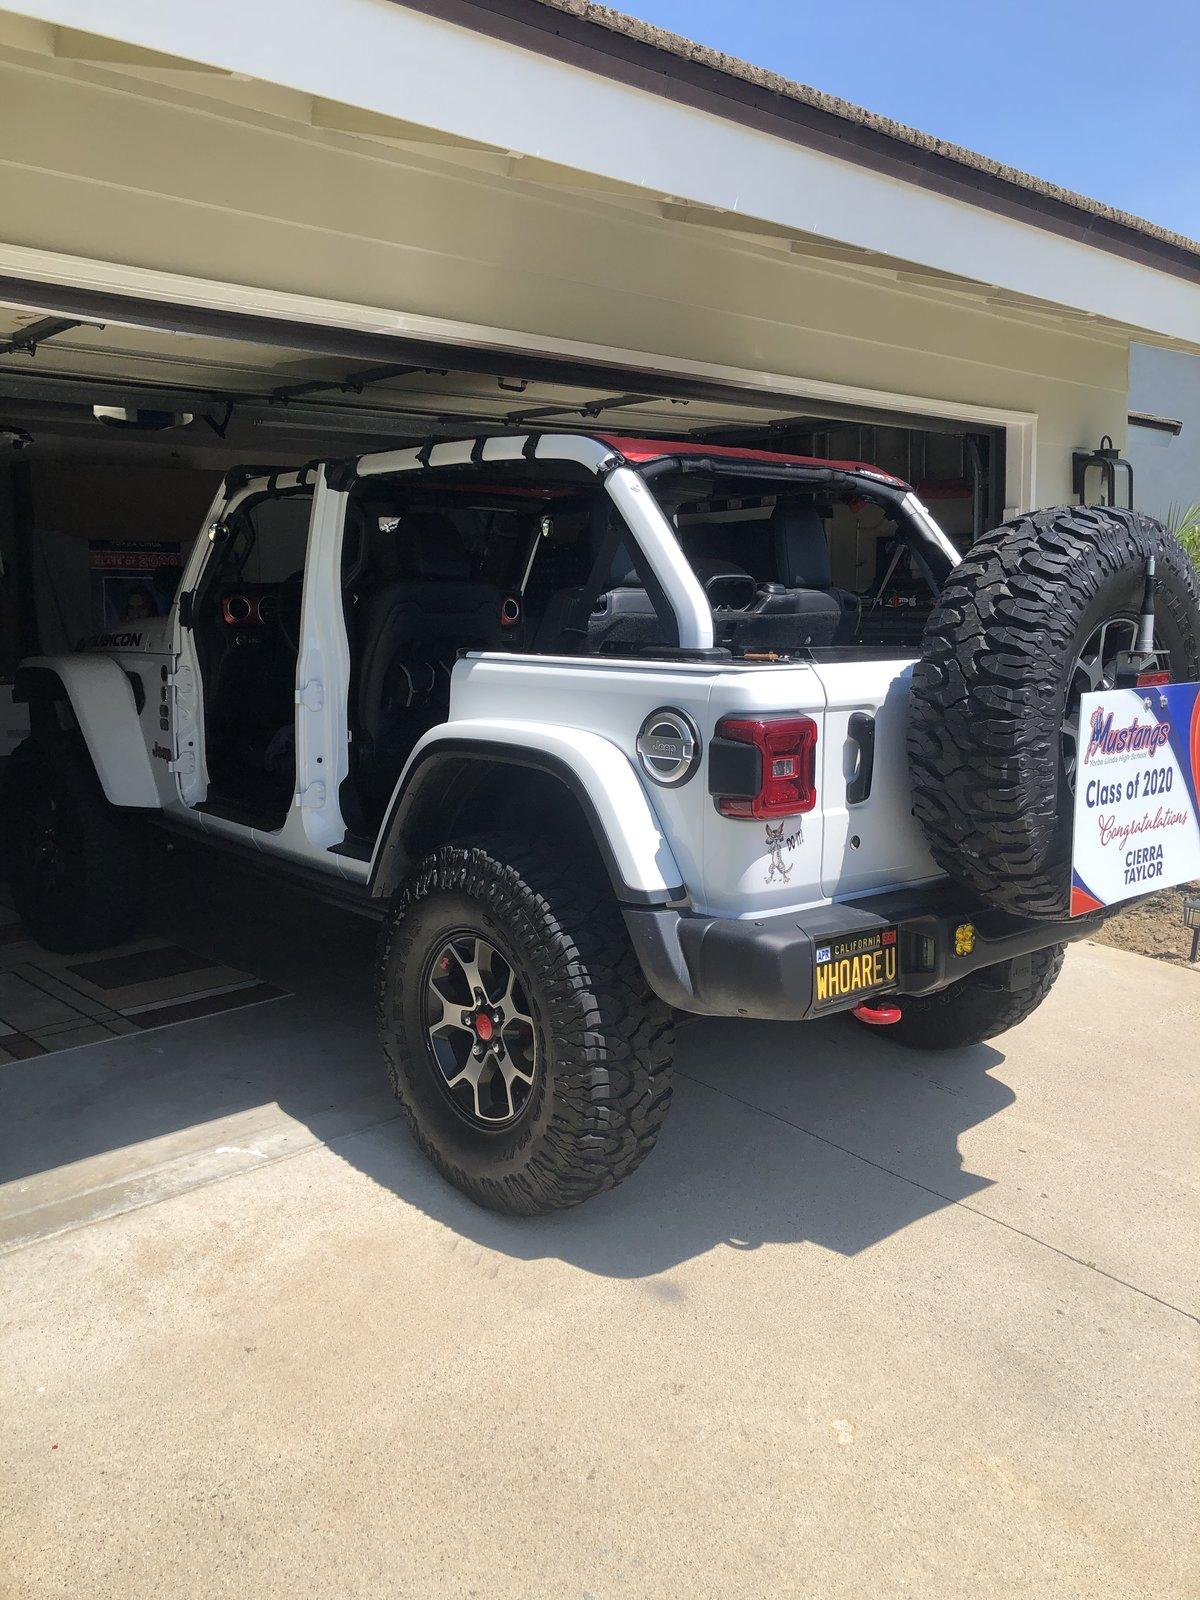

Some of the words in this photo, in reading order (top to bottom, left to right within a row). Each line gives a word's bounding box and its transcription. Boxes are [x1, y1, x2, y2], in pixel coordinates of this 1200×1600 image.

[1084, 706, 1171, 764] Mustangs
[152, 741, 171, 763] Jeep
[652, 740, 677, 755] Jeep
[1089, 758, 1104, 768] Yorba
[1104, 756, 1118, 766] Linda
[1118, 754, 1130, 764] High
[1130, 752, 1147, 761] School
[1086, 779, 1122, 808] Class
[1126, 771, 1140, 800] of
[1142, 766, 1173, 797] 2020
[1098, 806, 1188, 851] Congratulations
[1125, 844, 1164, 868] CIERRA
[1123, 861, 1163, 886] TAYLOR
[817, 948, 830, 962] APR
[834, 934, 881, 955] CALIFORNIA
